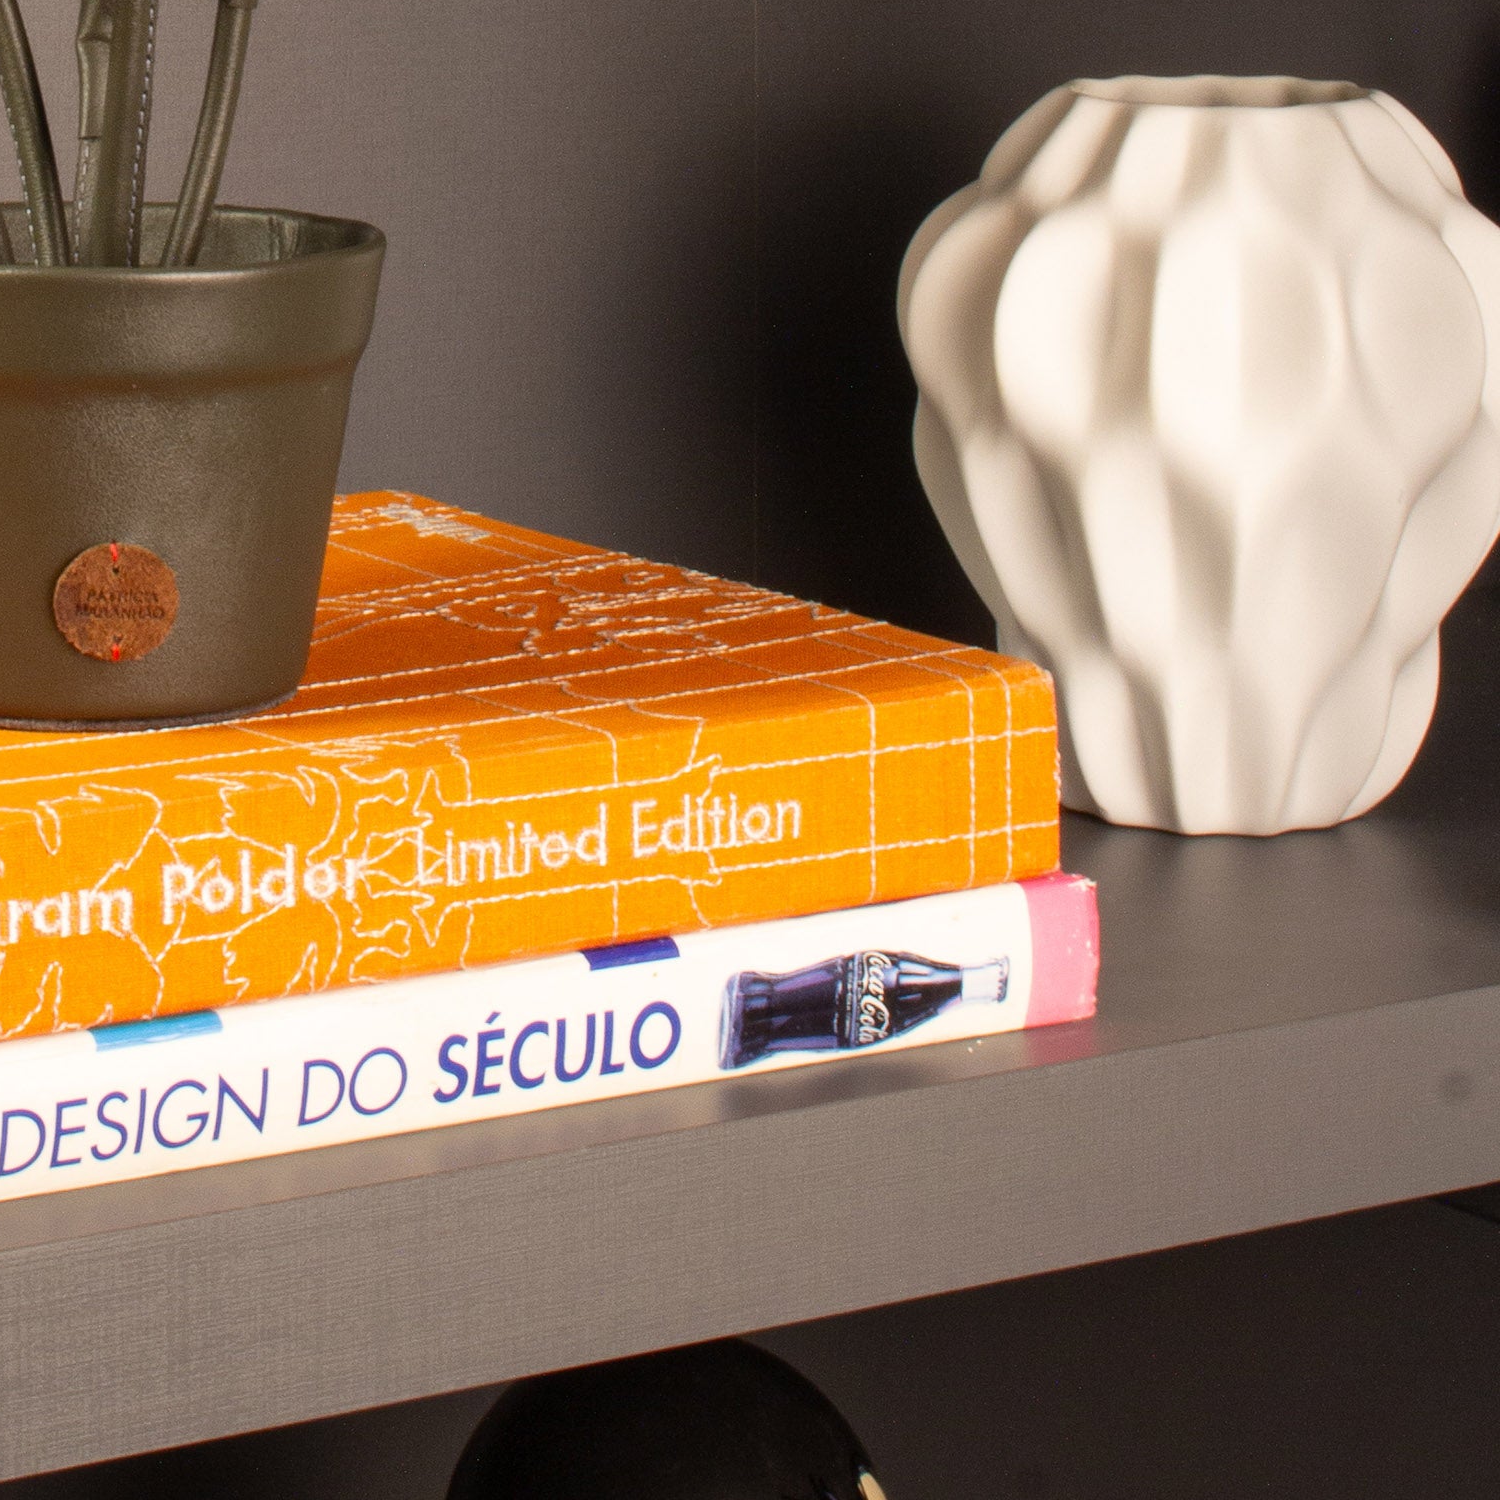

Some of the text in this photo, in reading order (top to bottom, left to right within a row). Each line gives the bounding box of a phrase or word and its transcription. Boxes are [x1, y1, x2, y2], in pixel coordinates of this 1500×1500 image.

[414, 801, 608, 887] Limited
[630, 794, 802, 858] Edition
[297, 1046, 408, 1127] DO
[432, 1000, 682, 1104] SÉCULO
